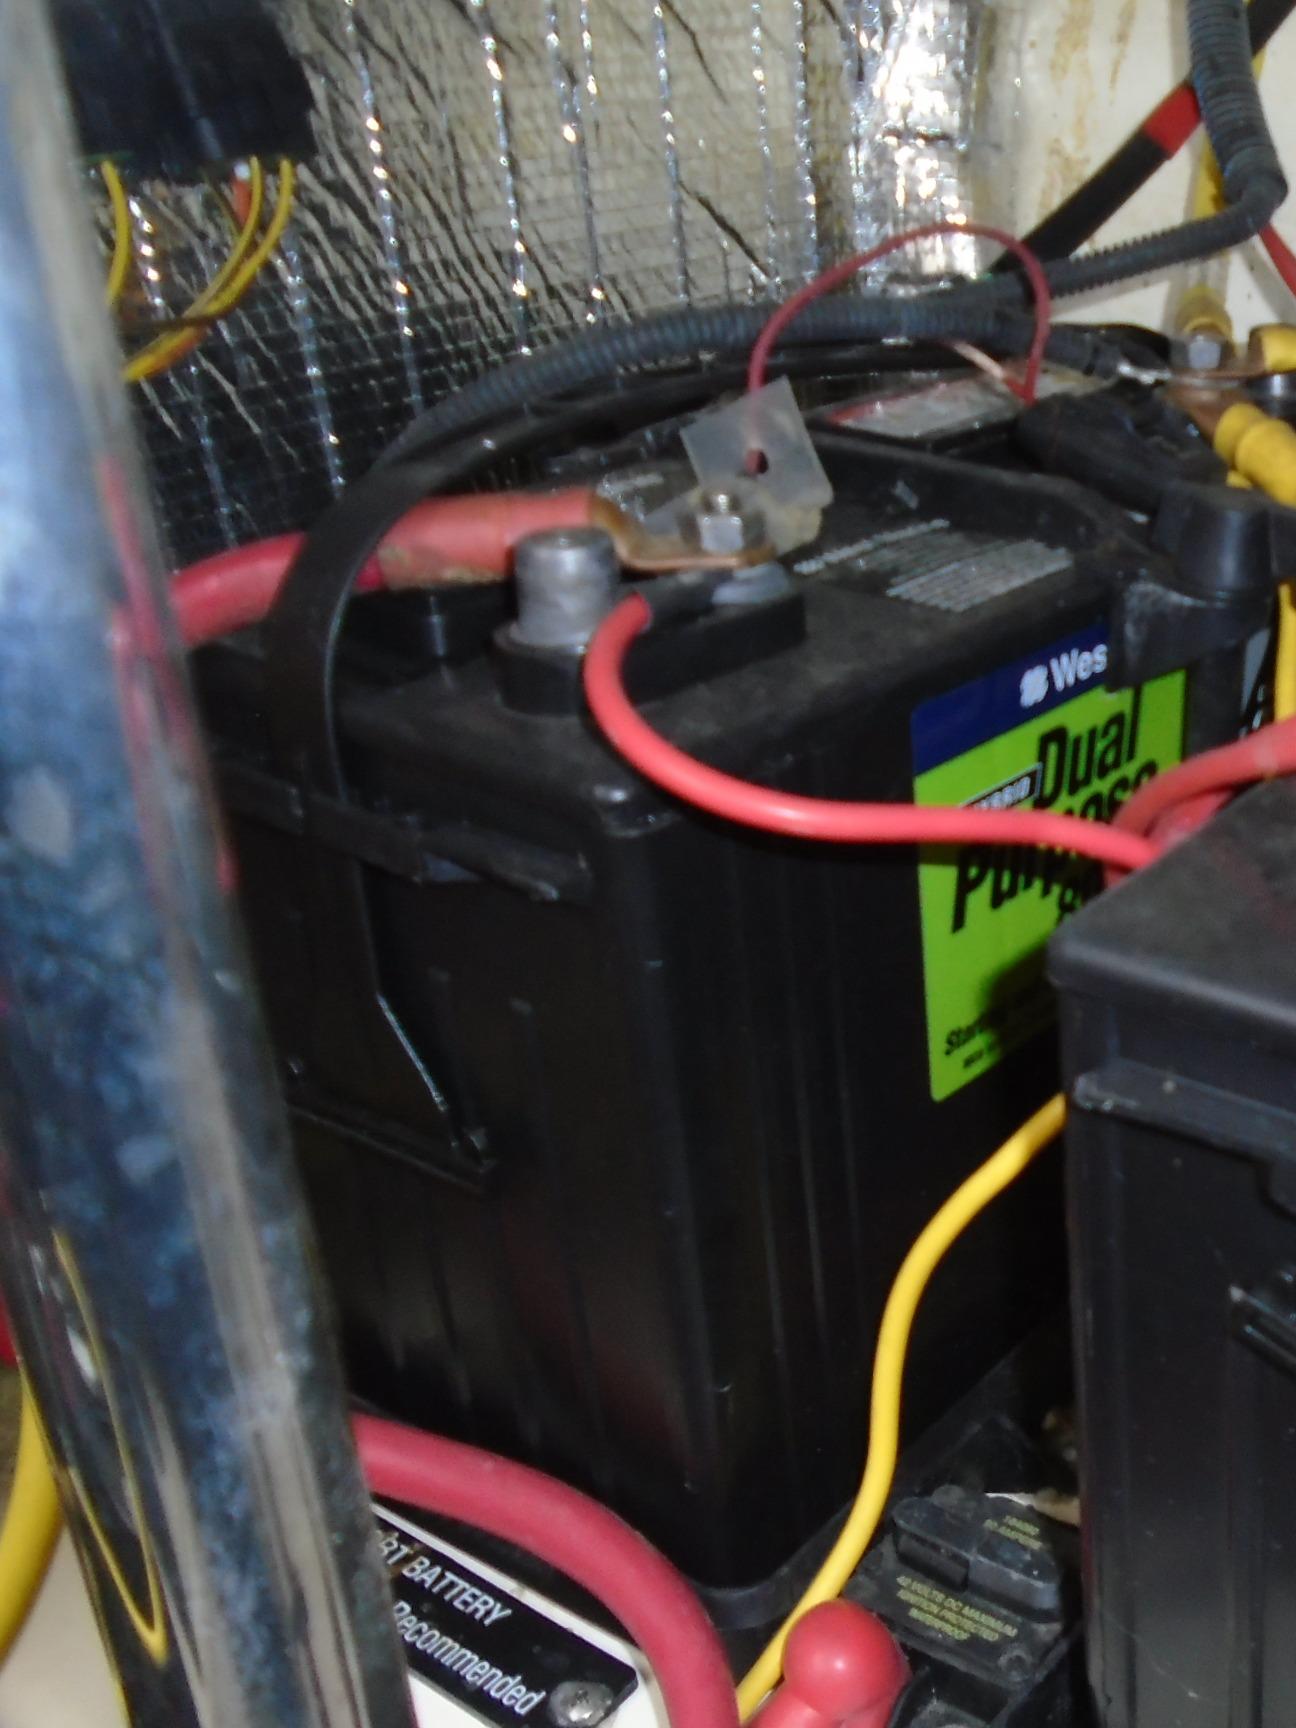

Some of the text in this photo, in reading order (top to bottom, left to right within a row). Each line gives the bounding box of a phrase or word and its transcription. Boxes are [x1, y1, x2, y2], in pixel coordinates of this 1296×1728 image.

[1049, 643, 1109, 692] Wes
[1036, 686, 1141, 808] Dual
[402, 1556, 513, 1627] BATTERY
[393, 1600, 547, 1716] Recommended
